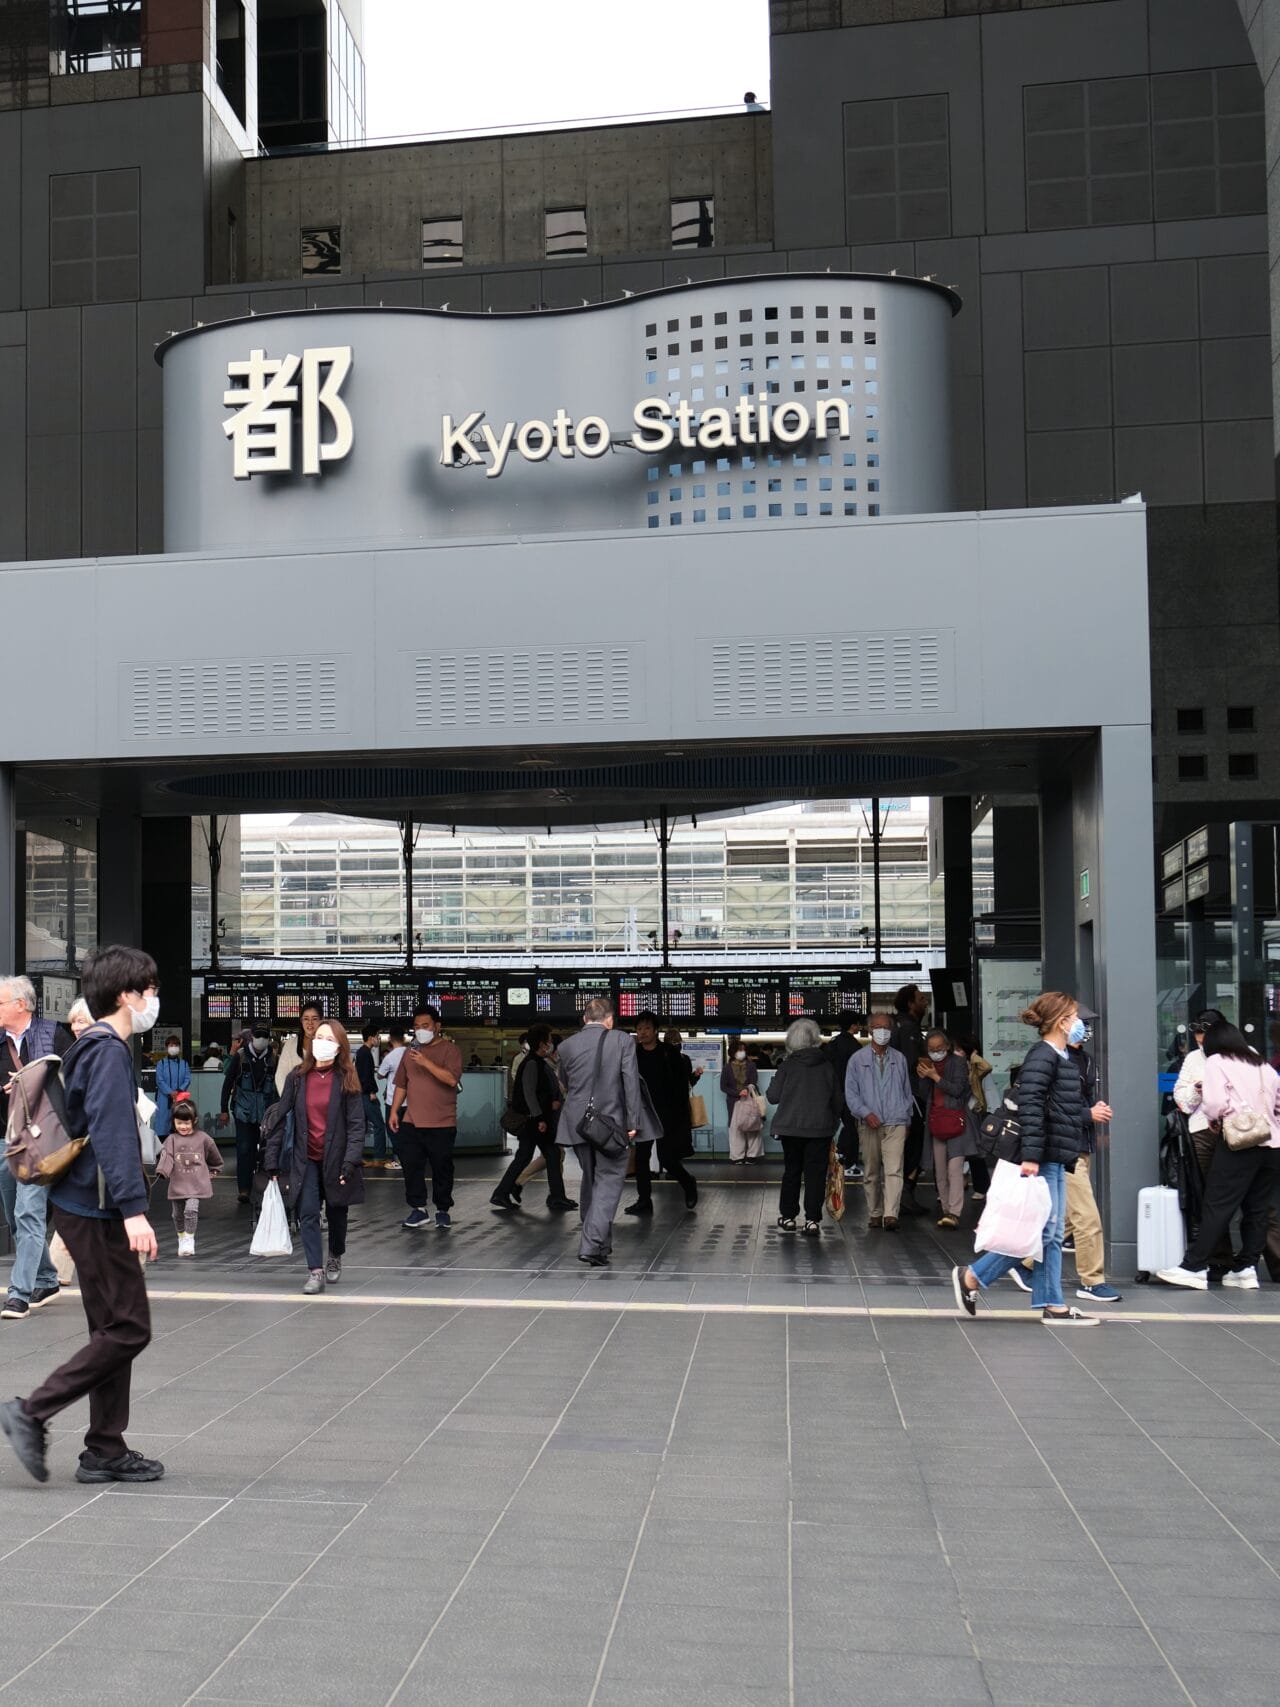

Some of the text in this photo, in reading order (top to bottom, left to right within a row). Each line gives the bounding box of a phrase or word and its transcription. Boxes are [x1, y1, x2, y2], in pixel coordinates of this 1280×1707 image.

[222, 346, 850, 480] 都 Kyoto Station
